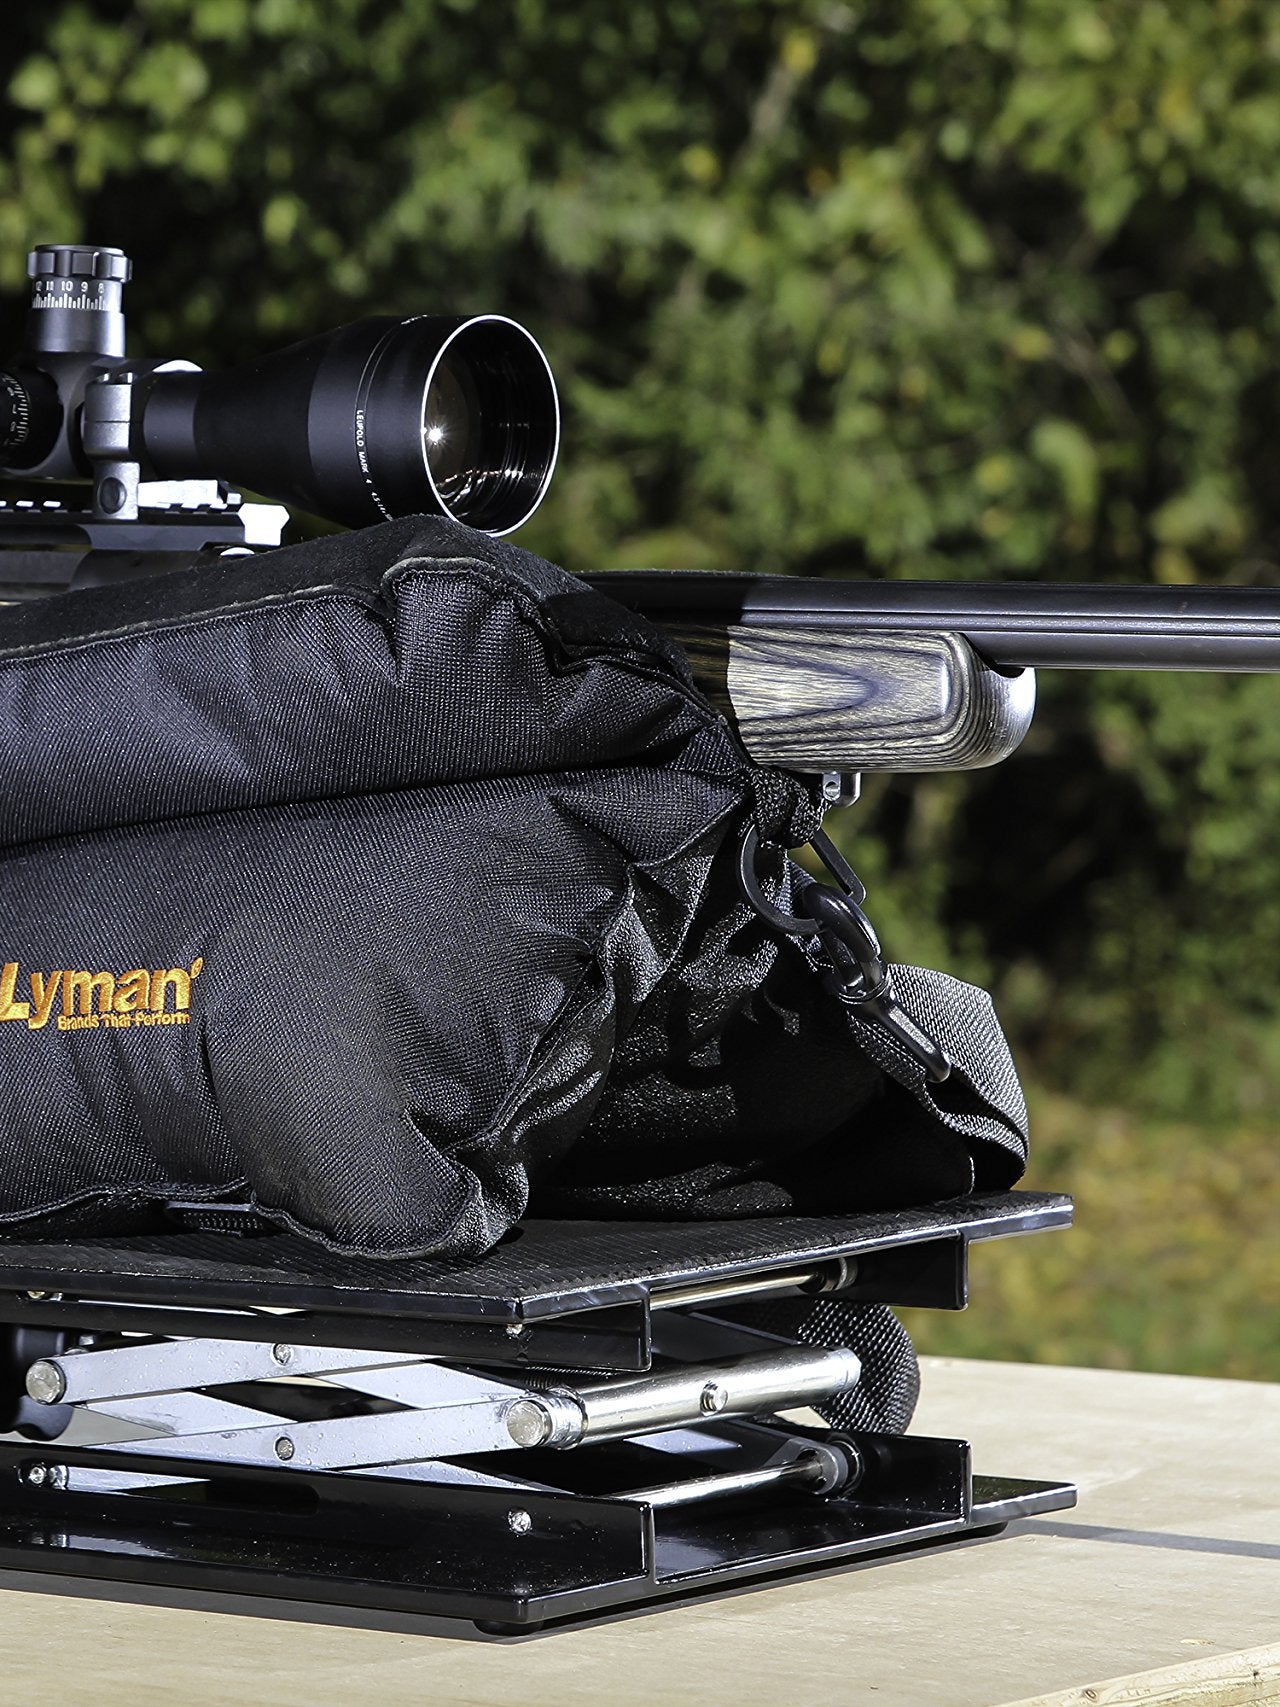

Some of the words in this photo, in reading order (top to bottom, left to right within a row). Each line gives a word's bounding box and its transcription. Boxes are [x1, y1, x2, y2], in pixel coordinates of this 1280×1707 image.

[61, 280, 74, 292] 10
[80, 281, 89, 293] 9
[97, 282, 106, 295] 8
[356, 409, 365, 448] LEUPOLD
[358, 451, 370, 474] MARK
[57, 1013, 100, 1031] Brands
